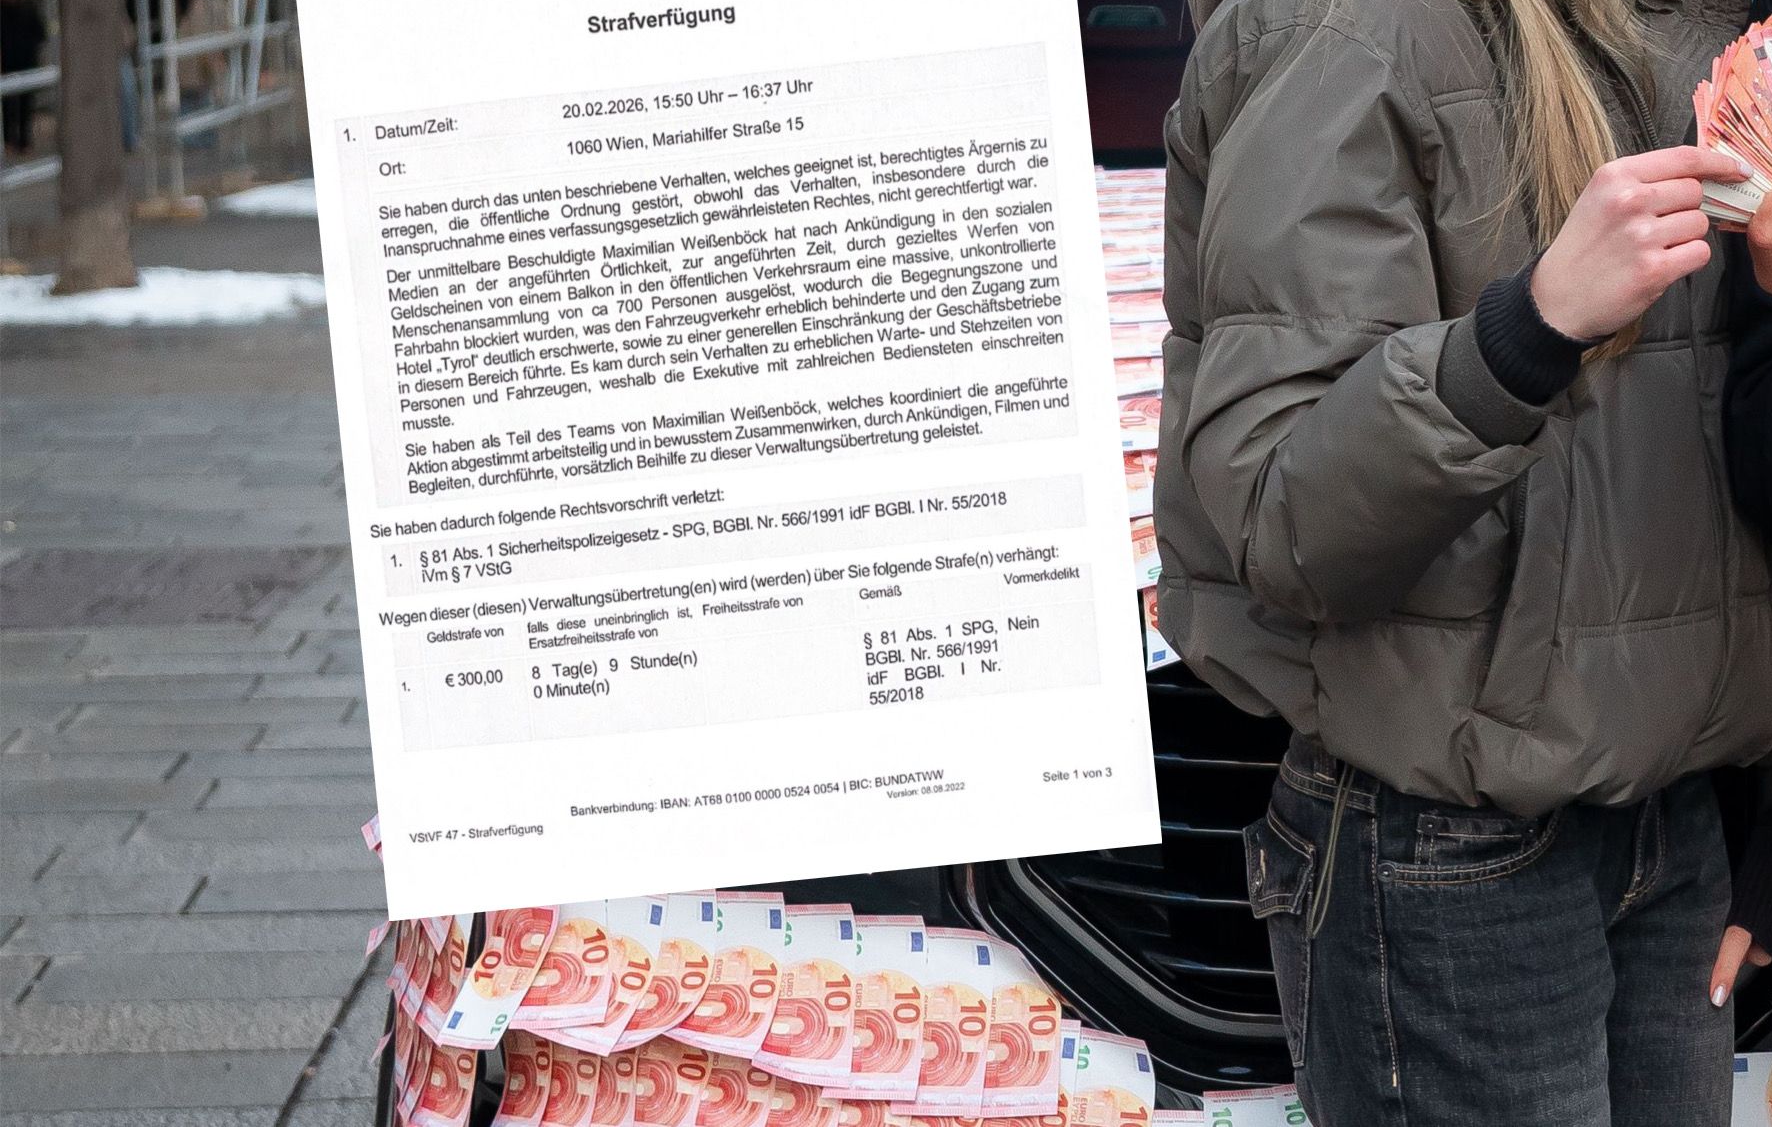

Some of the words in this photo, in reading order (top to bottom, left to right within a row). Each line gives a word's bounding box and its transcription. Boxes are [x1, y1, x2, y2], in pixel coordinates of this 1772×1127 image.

[581, 927, 609, 965] 10
[474, 950, 502, 983] 10
[620, 957, 651, 991] 10
[680, 955, 709, 991] 10
[749, 962, 778, 999] 10
[786, 972, 795, 998] EURO
[823, 973, 852, 1012] 10
[854, 983, 863, 1008] EURO
[892, 986, 921, 1025] 10
[958, 999, 988, 1037] 10
[1028, 997, 1057, 1037] 10
[490, 1013, 508, 1035] 10
[1076, 1044, 1091, 1071] 10
[1079, 1097, 1087, 1123] EURO
[1284, 1099, 1306, 1126] 10
